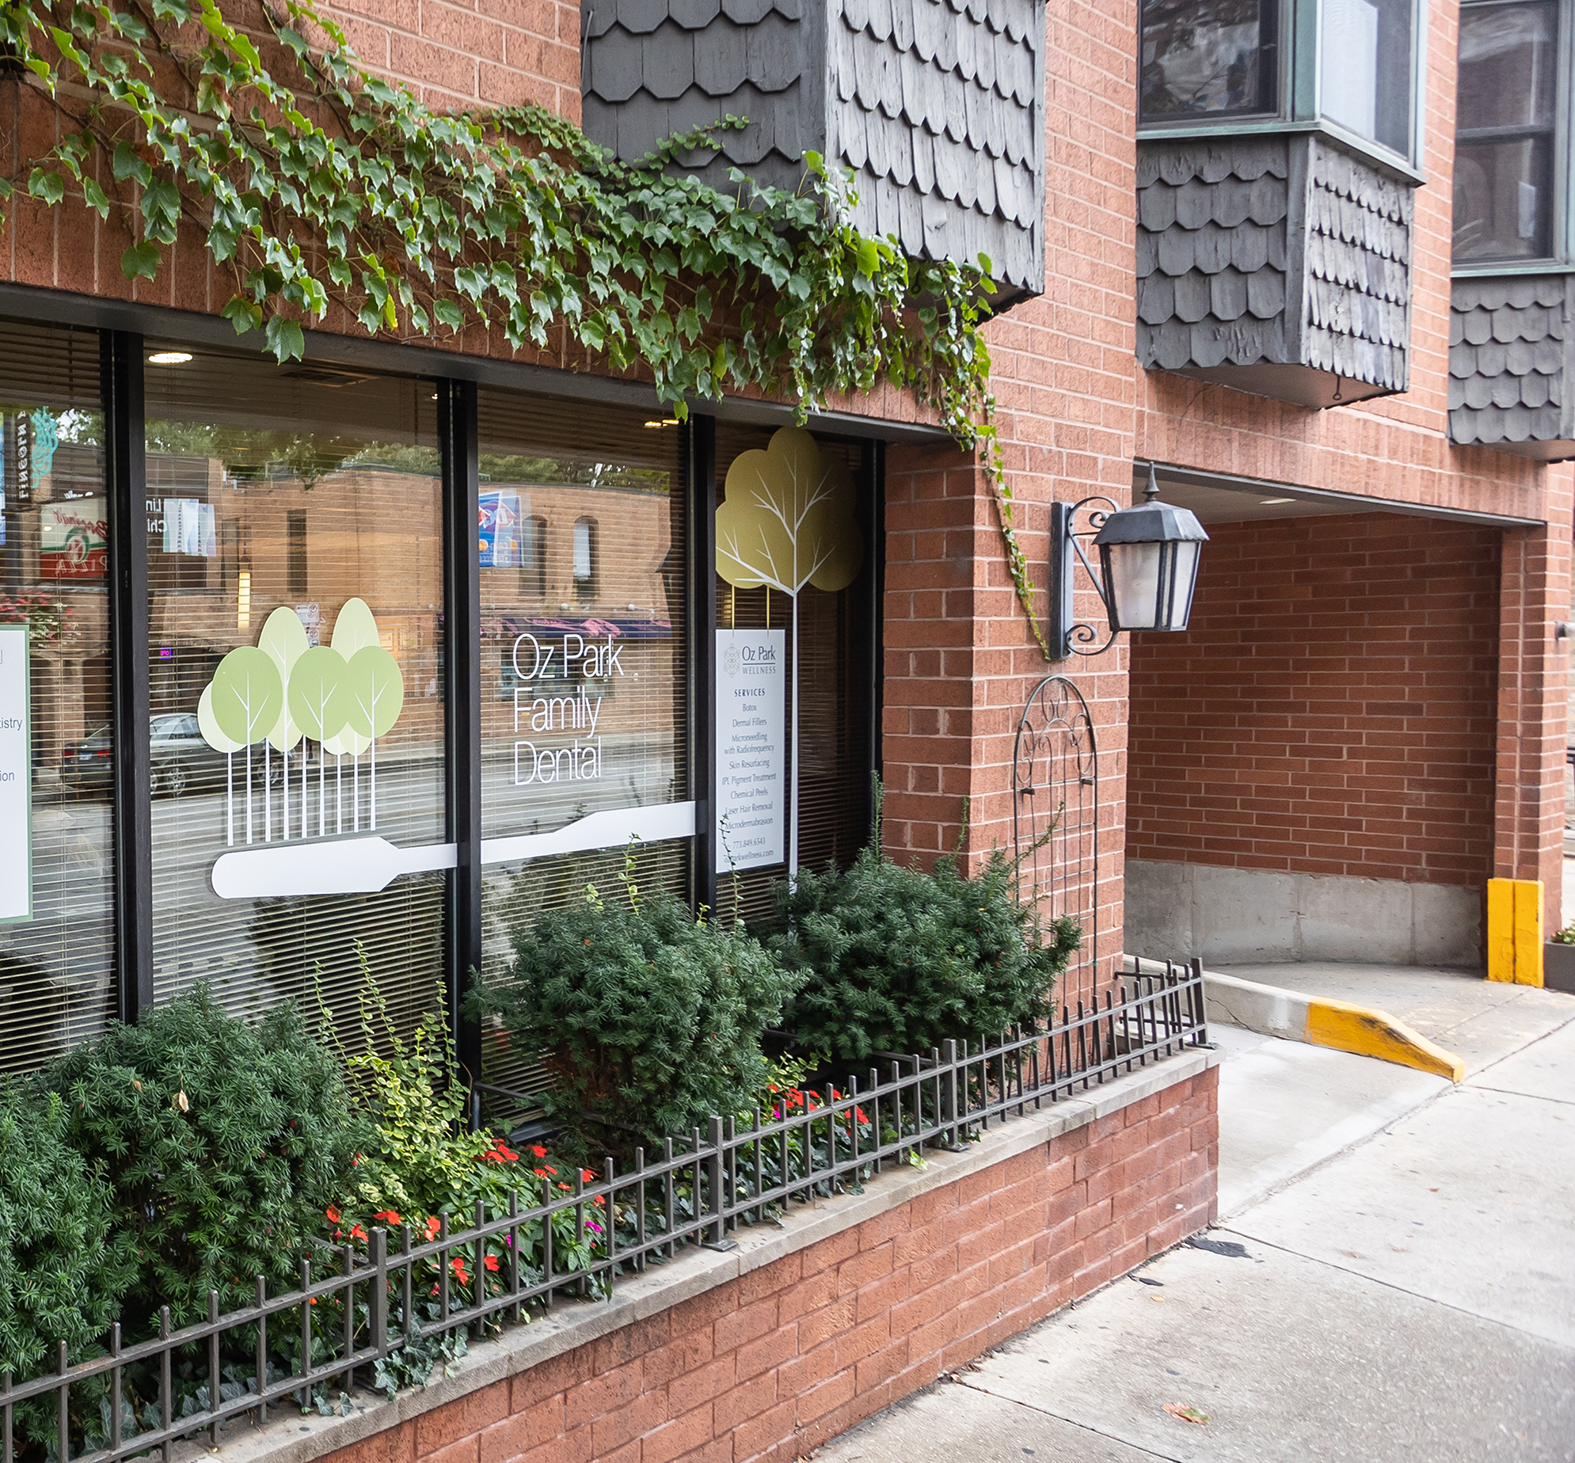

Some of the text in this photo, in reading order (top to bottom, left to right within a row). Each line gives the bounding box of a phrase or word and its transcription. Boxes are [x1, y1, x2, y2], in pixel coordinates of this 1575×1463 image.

[513, 634, 624, 680] Oz Park
[742, 645, 776, 661] Oz Park
[742, 664, 777, 675] WELLNESS
[734, 688, 766, 697] SERVICES
[515, 685, 602, 739] Family
[743, 703, 757, 712] Botox
[733, 716, 767, 728] Dermal Fillers
[731, 732, 768, 744] Microneedling
[724, 743, 775, 755] with Radiofrequency
[515, 736, 603, 786] Dental
[729, 758, 771, 770] Skin Resurfacing
[722, 772, 777, 787] IPL Pigment Treatment
[730, 788, 769, 800] Chemical Peels
[739, 804, 751, 814] Hair
[751, 801, 773, 812] Removal
[725, 817, 773, 830] Microdermabrasion
[733, 837, 766, 849] 773.849.6543
